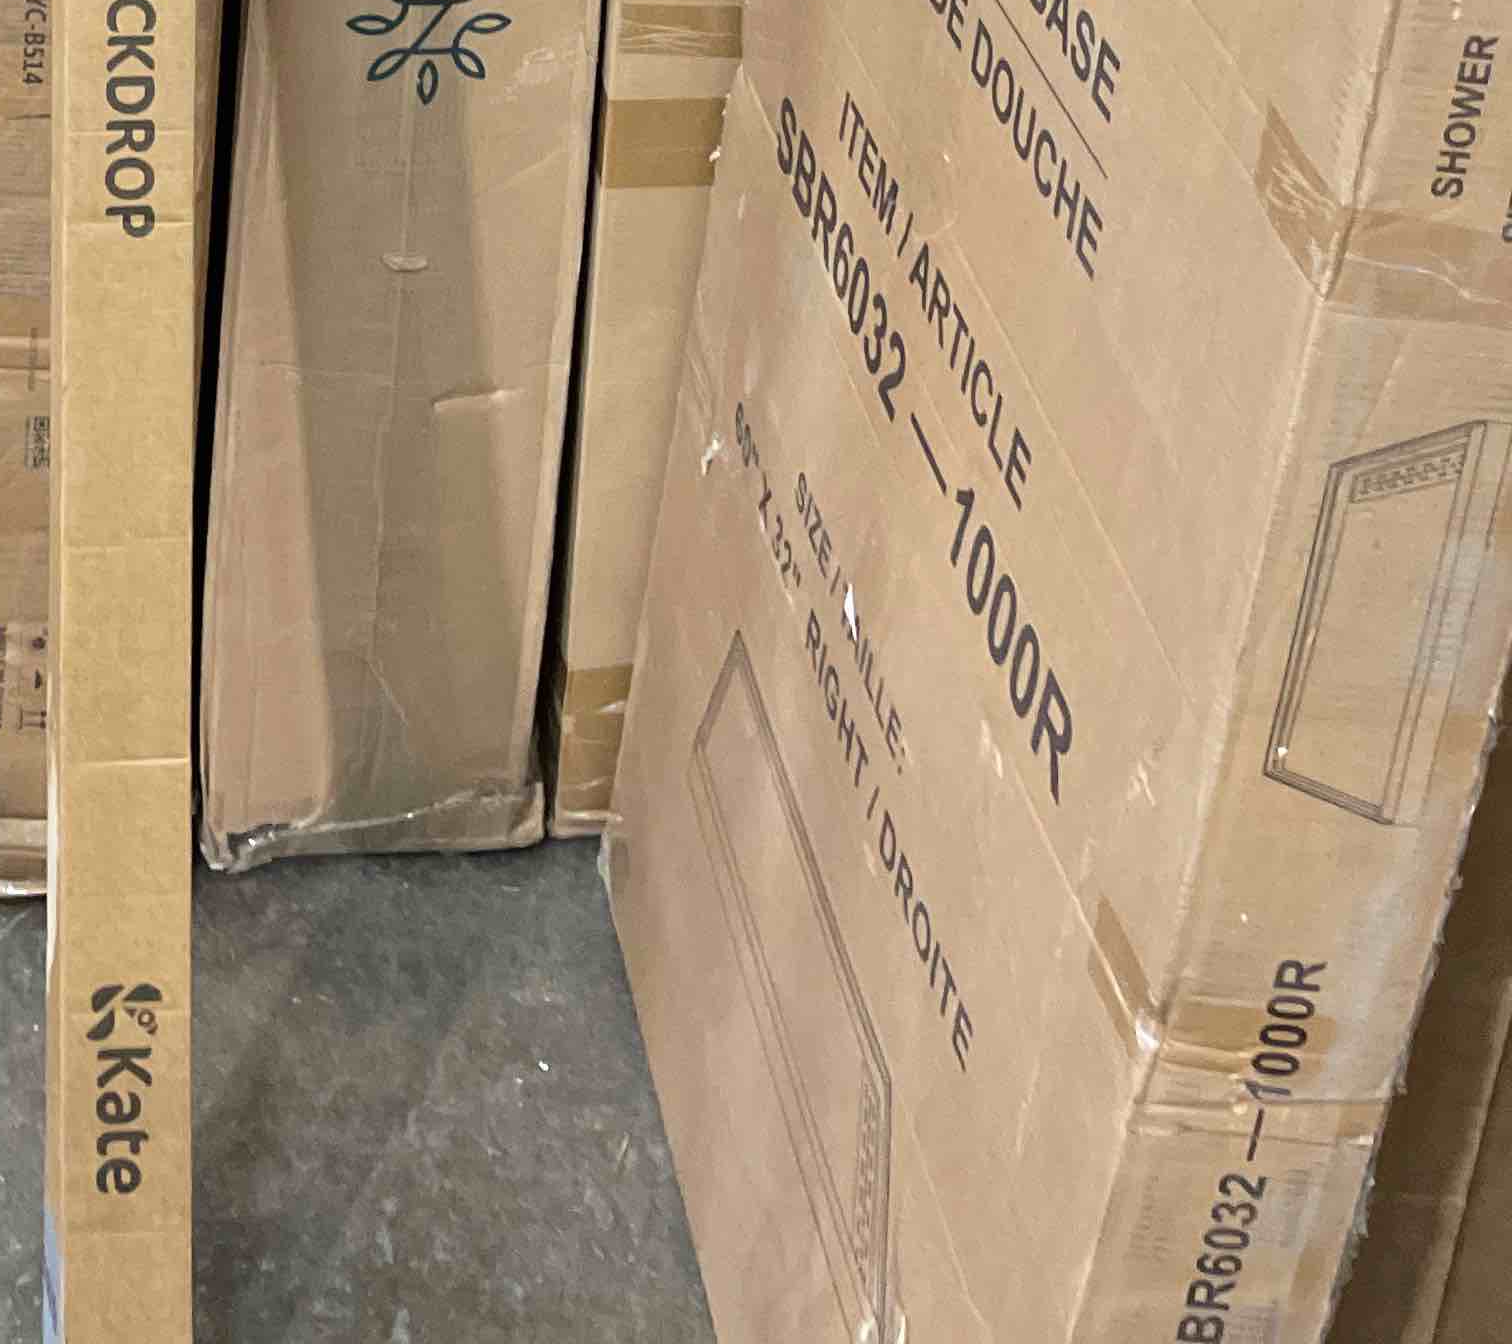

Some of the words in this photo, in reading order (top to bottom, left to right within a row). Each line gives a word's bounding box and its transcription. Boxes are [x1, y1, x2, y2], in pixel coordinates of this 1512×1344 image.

[971, 17, 1104, 281] DOUCHE
[1431, 33, 1499, 201] SHOWER
[839, 91, 900, 236] ITEM
[908, 241, 1033, 512] ARTICLE
[794, 471, 832, 579] SIZE
[805, 607, 869, 788] RIGHT
[878, 810, 974, 1073] DROITE
[95, 1047, 154, 1194] Kate
